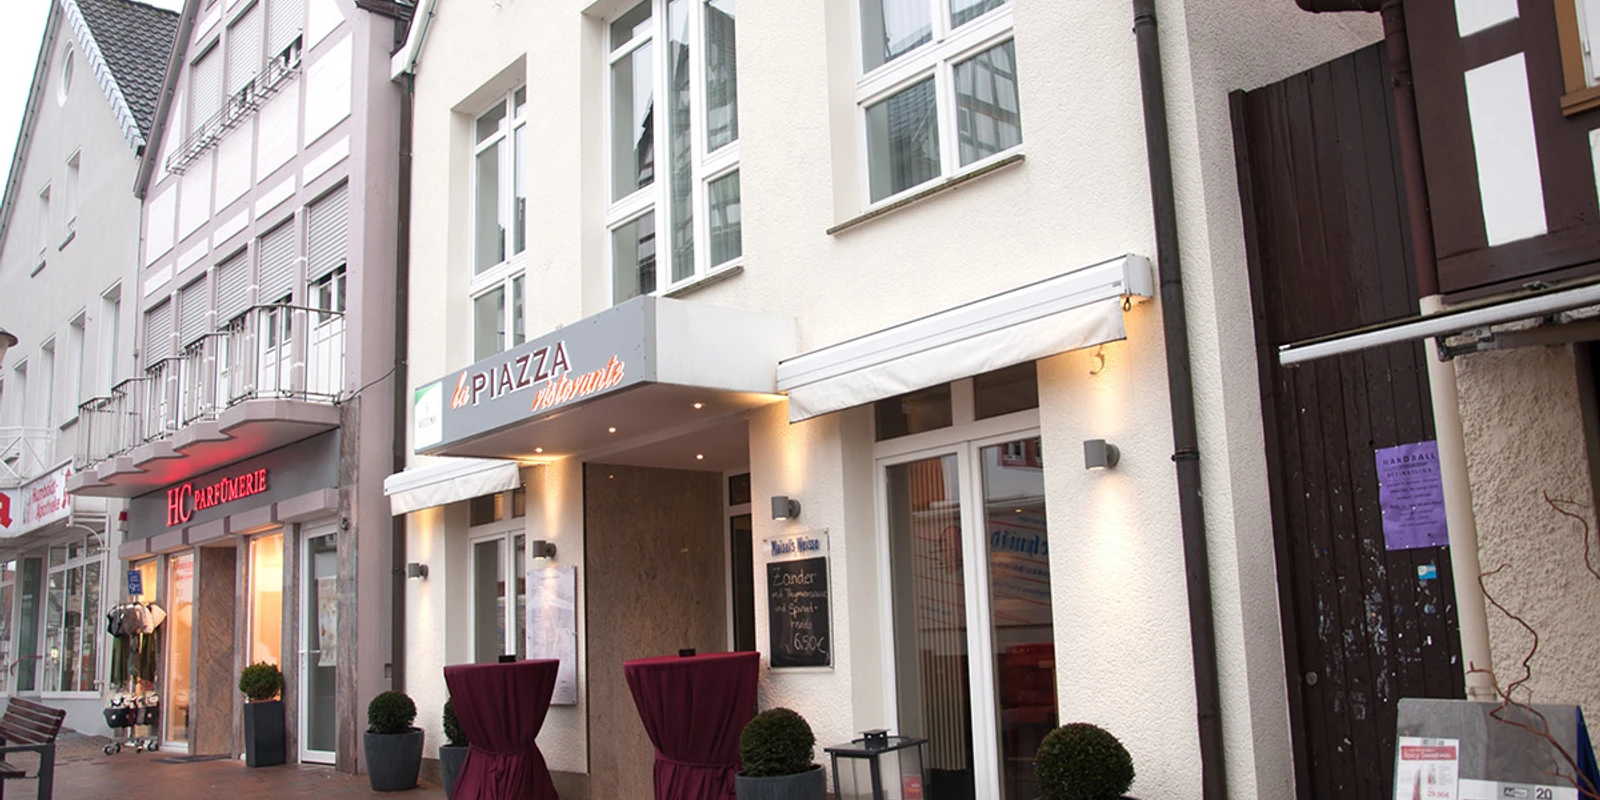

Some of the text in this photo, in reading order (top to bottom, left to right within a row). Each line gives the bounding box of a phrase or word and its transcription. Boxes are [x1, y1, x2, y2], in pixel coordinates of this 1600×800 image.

[451, 340, 573, 410] la PIAZZA
[531, 354, 624, 412] ristorante
[1383, 452, 1436, 466] HANDBALL
[166, 468, 267, 527] HC PARFÜMERIE
[772, 567, 817, 586] Zander
